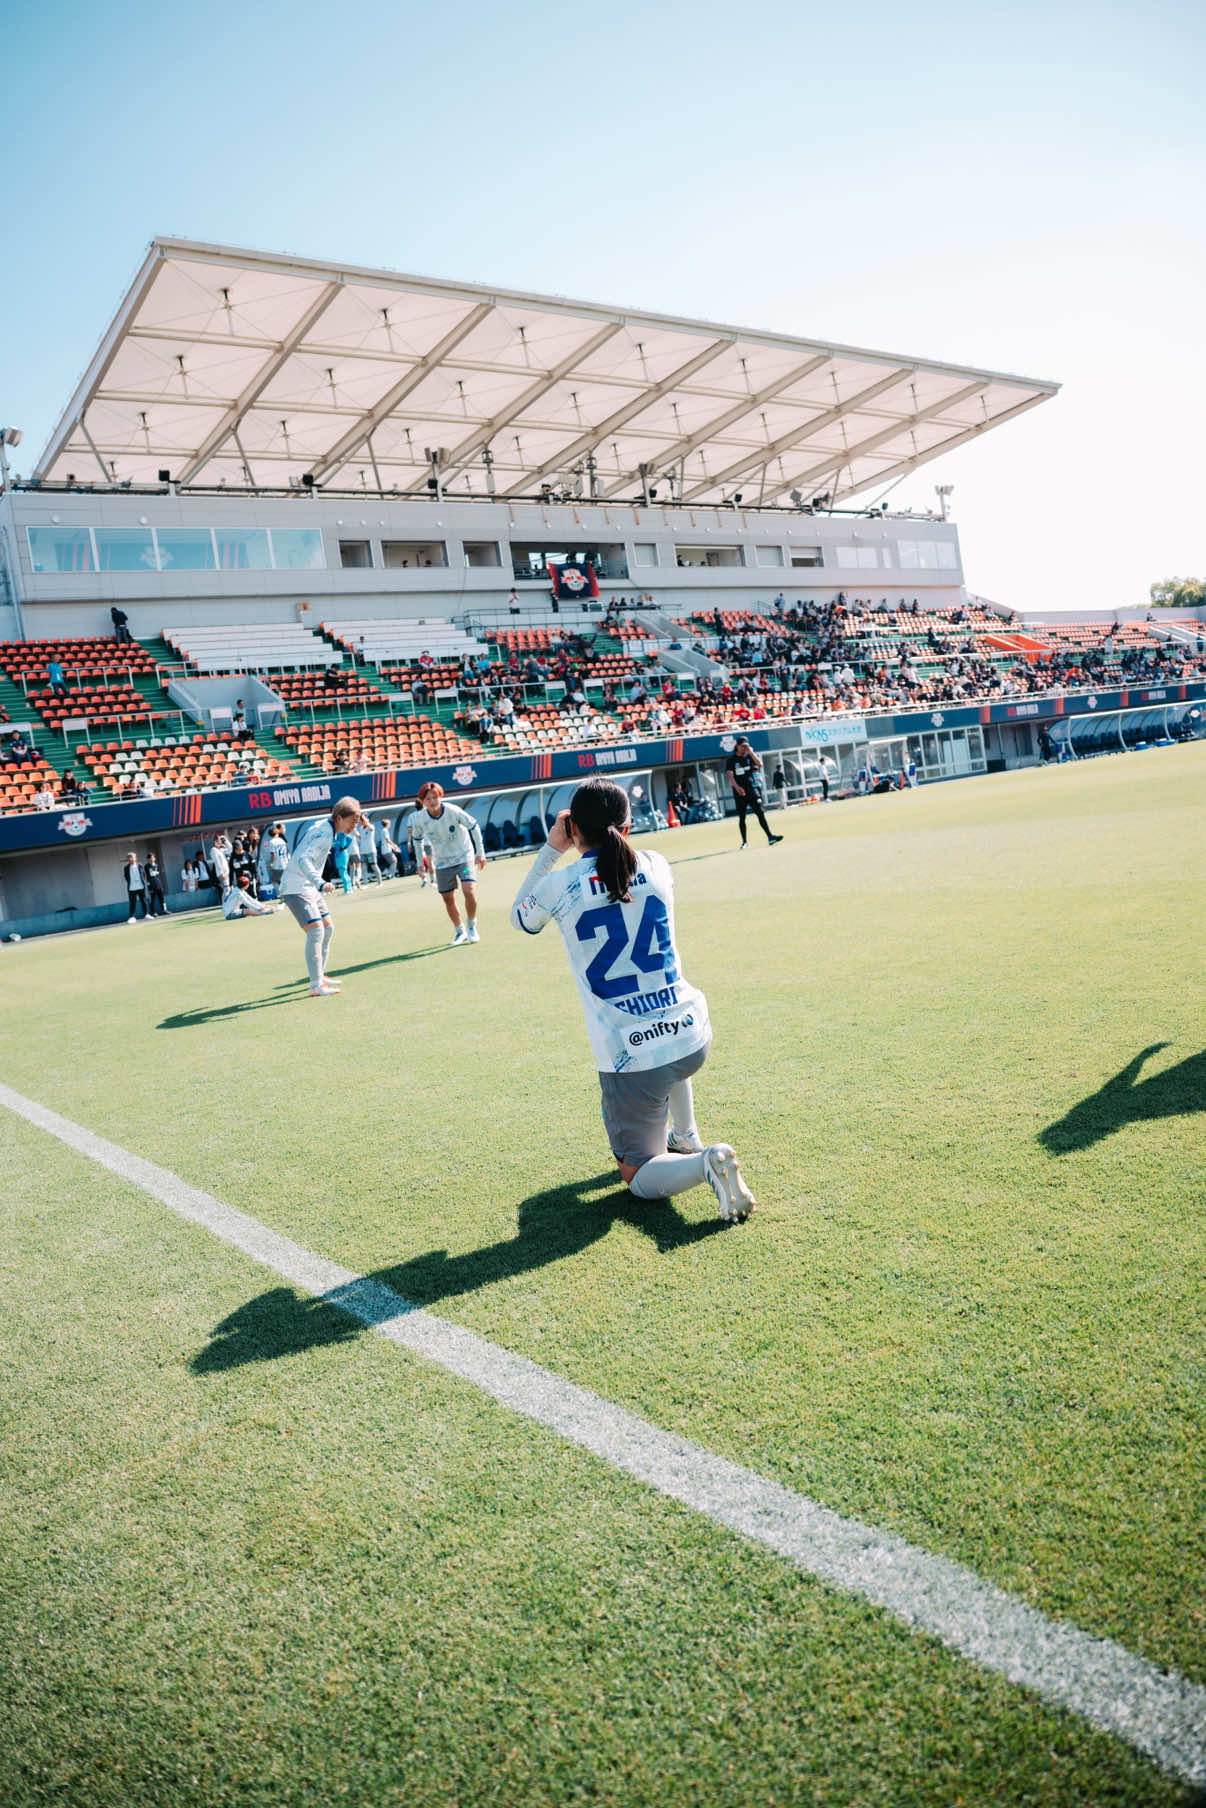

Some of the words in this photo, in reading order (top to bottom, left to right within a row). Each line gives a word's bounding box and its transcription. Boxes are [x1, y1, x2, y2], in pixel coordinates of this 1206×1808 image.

[248, 791, 272, 809] RB
[575, 894, 681, 1000] 24
[629, 1019, 680, 1046] @nifty
